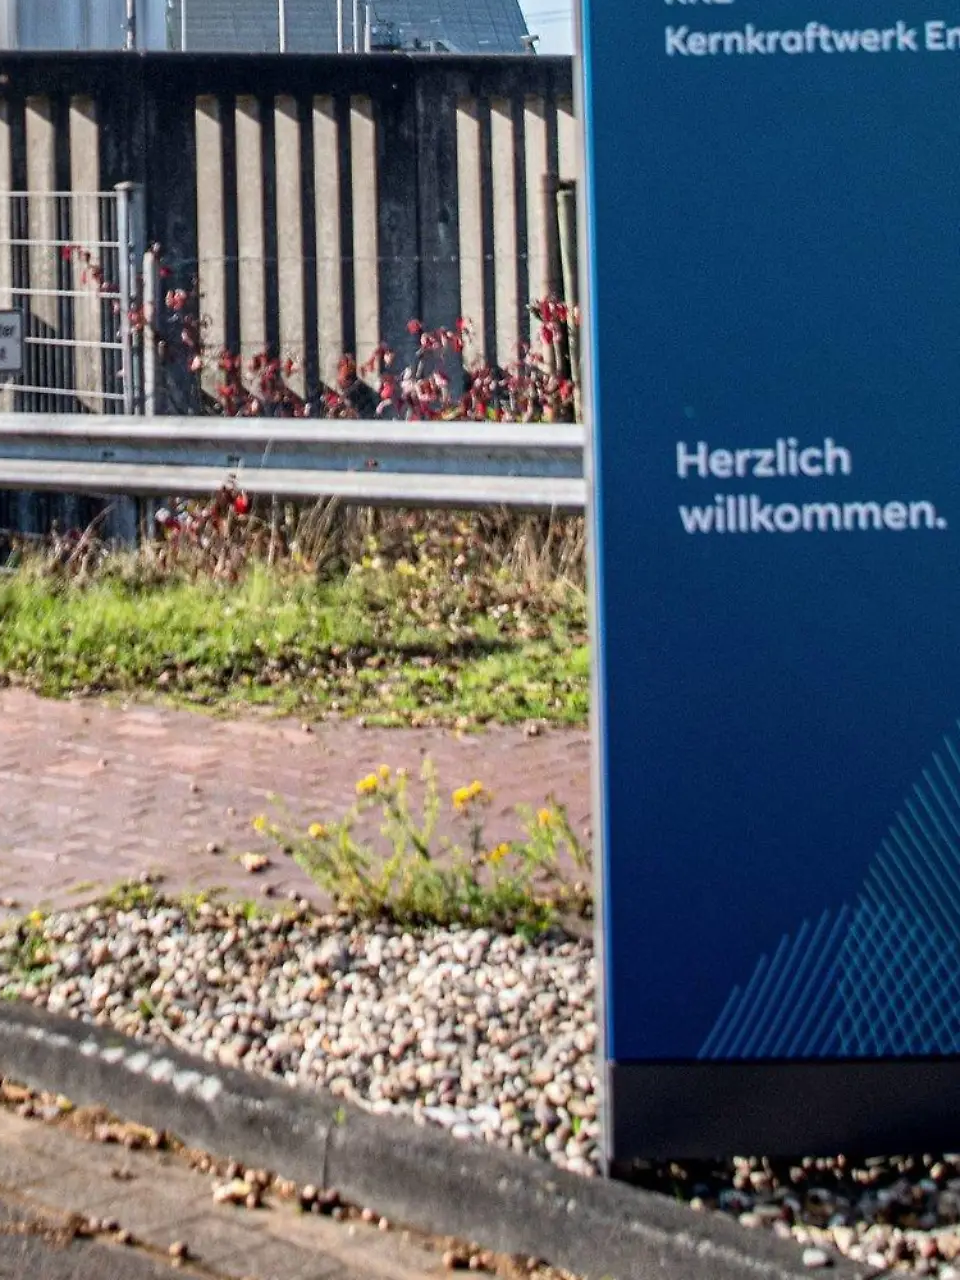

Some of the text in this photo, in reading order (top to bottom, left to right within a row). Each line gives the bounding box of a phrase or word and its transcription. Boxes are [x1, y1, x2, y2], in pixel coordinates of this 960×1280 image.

[665, 21, 918, 56] Kernkraftwerk
[676, 438, 852, 478] Herzlich
[678, 494, 948, 534] willkommen.
